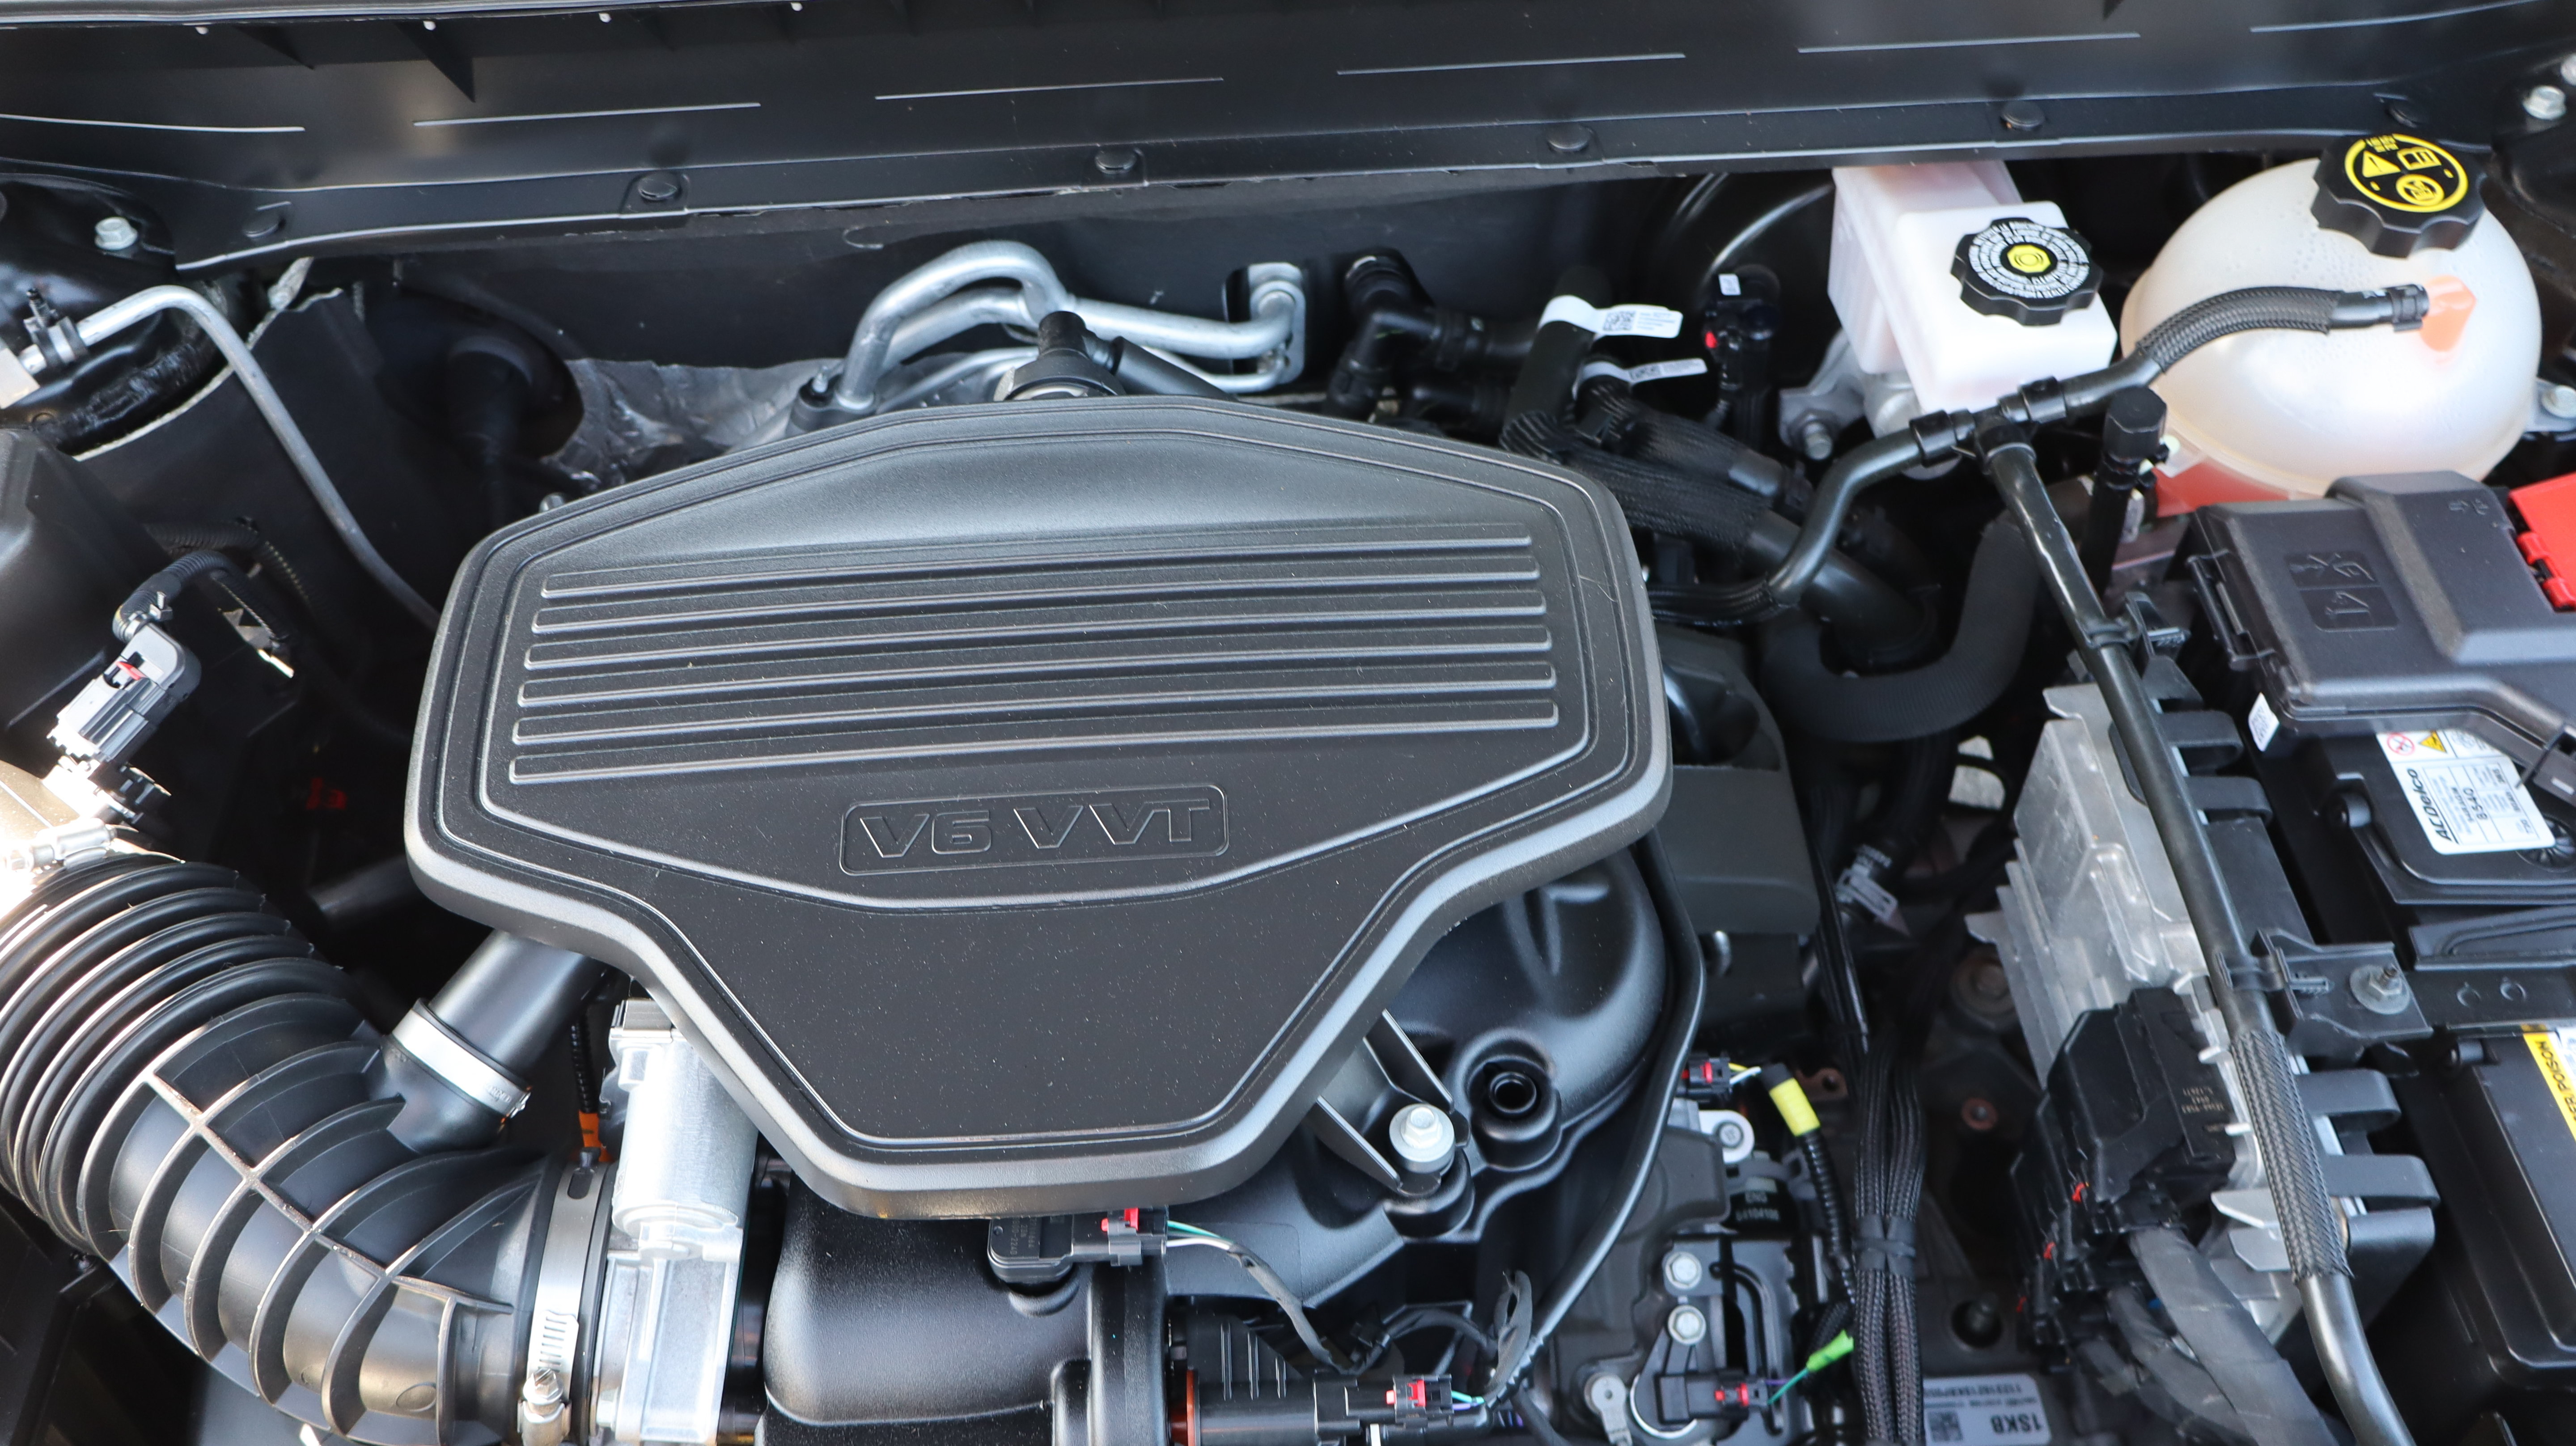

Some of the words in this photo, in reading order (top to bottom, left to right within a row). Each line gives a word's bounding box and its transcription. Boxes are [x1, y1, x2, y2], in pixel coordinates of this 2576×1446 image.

[859, 810, 991, 858] V6
[1013, 798, 1210, 849] VVT
[2407, 768, 2452, 841] ACDelco
[2462, 787, 2487, 820] 8540
